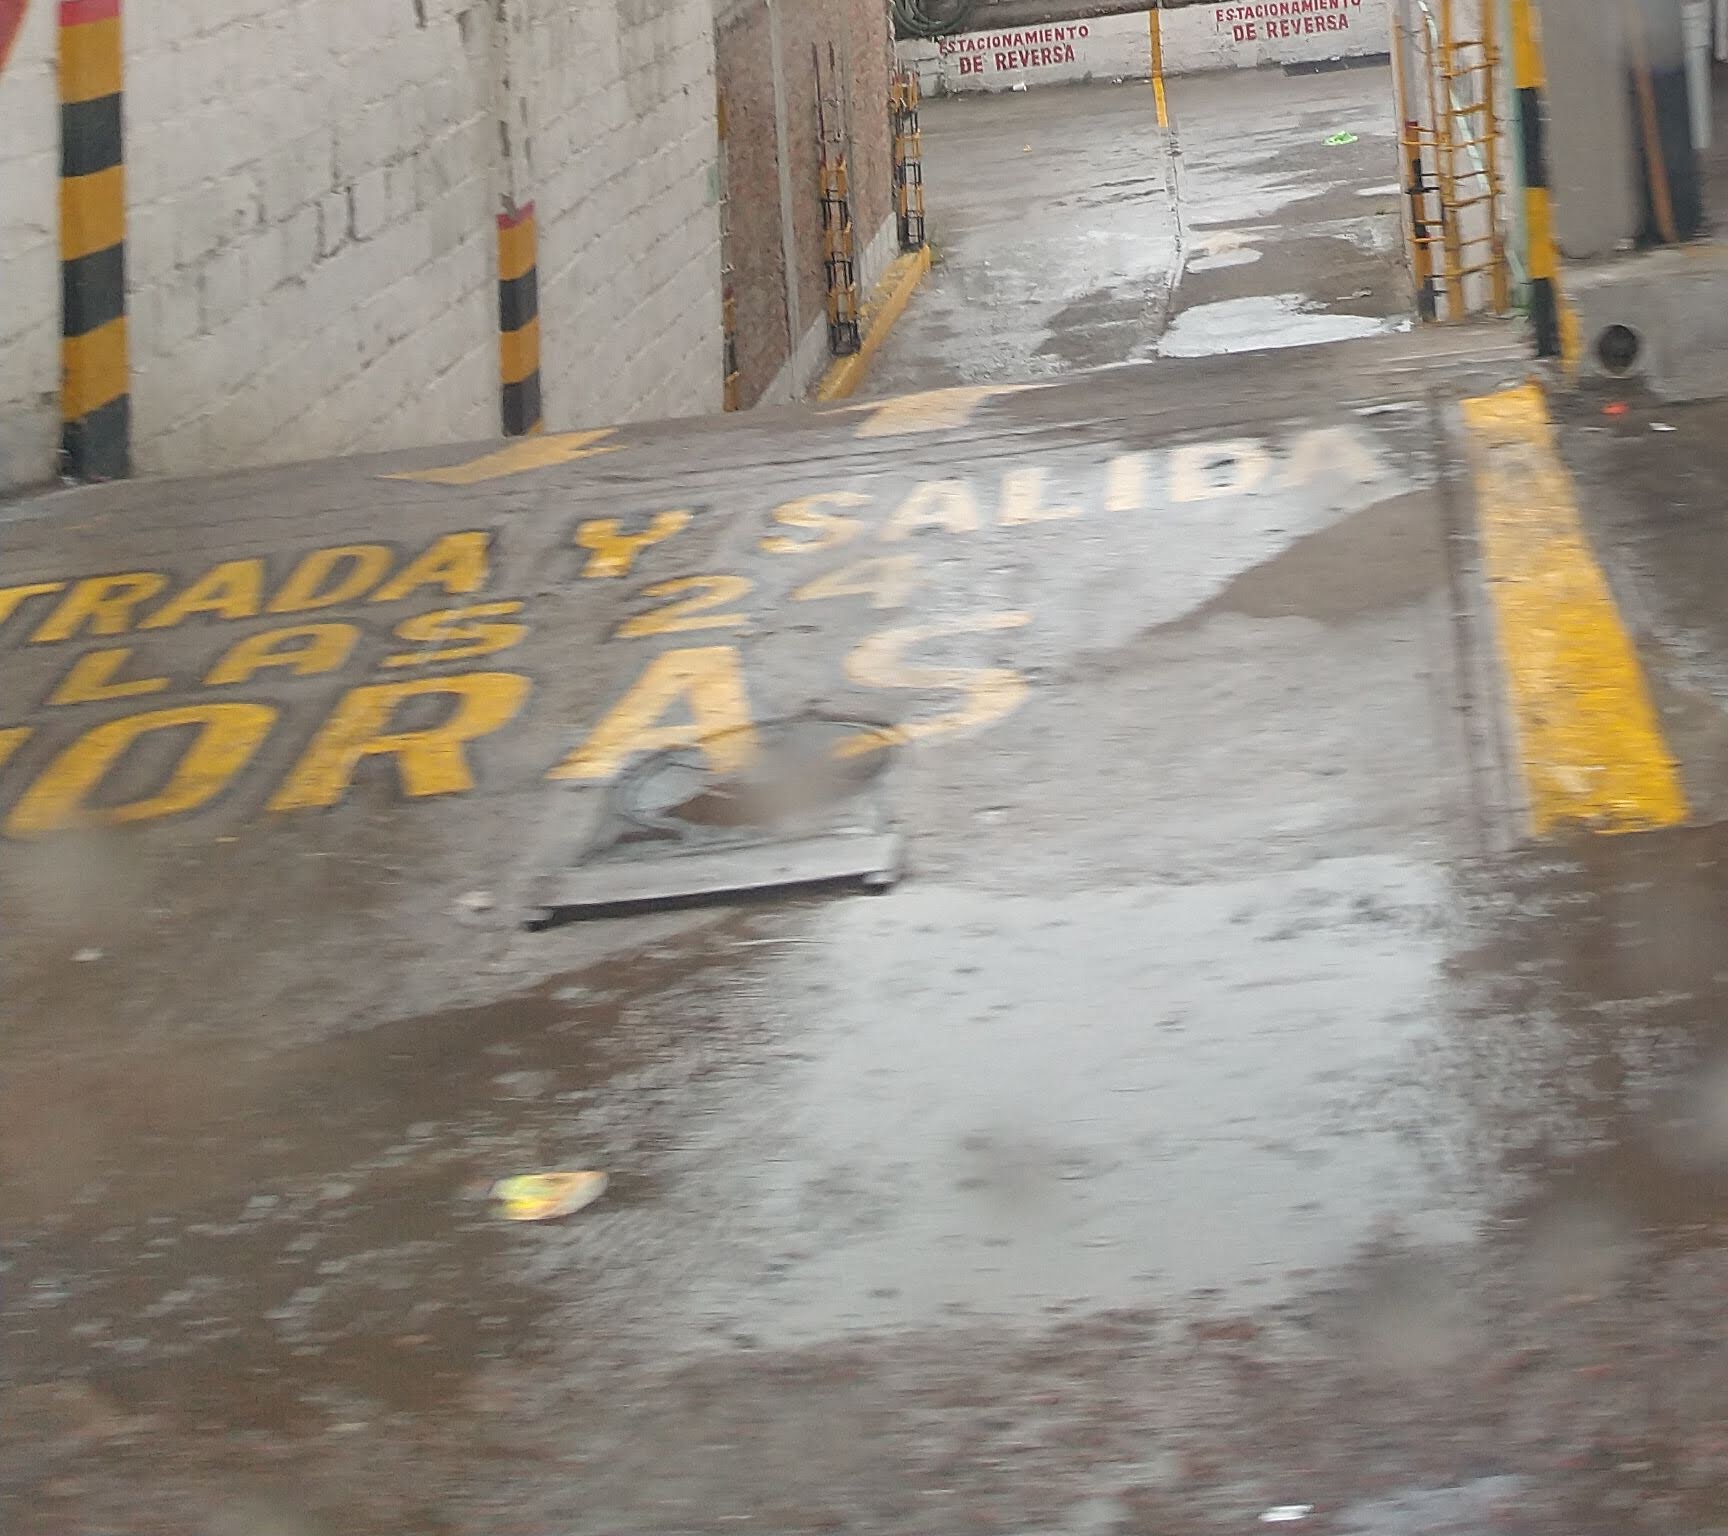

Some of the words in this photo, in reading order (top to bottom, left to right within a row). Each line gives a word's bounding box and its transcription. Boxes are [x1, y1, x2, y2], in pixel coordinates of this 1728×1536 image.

[939, 25, 1089, 55] ESTACIONAMIENTO
[959, 55, 984, 75] DE
[995, 44, 1075, 71] REVERSA
[1233, 23, 1257, 42] DE
[1266, 13, 1349, 39] REVERSA
[574, 509, 698, 579] Y
[760, 426, 1386, 556] SALIDA
[45, 600, 530, 706] LAS
[616, 554, 927, 640] 24
[0, 611, 1034, 830] ORAS
